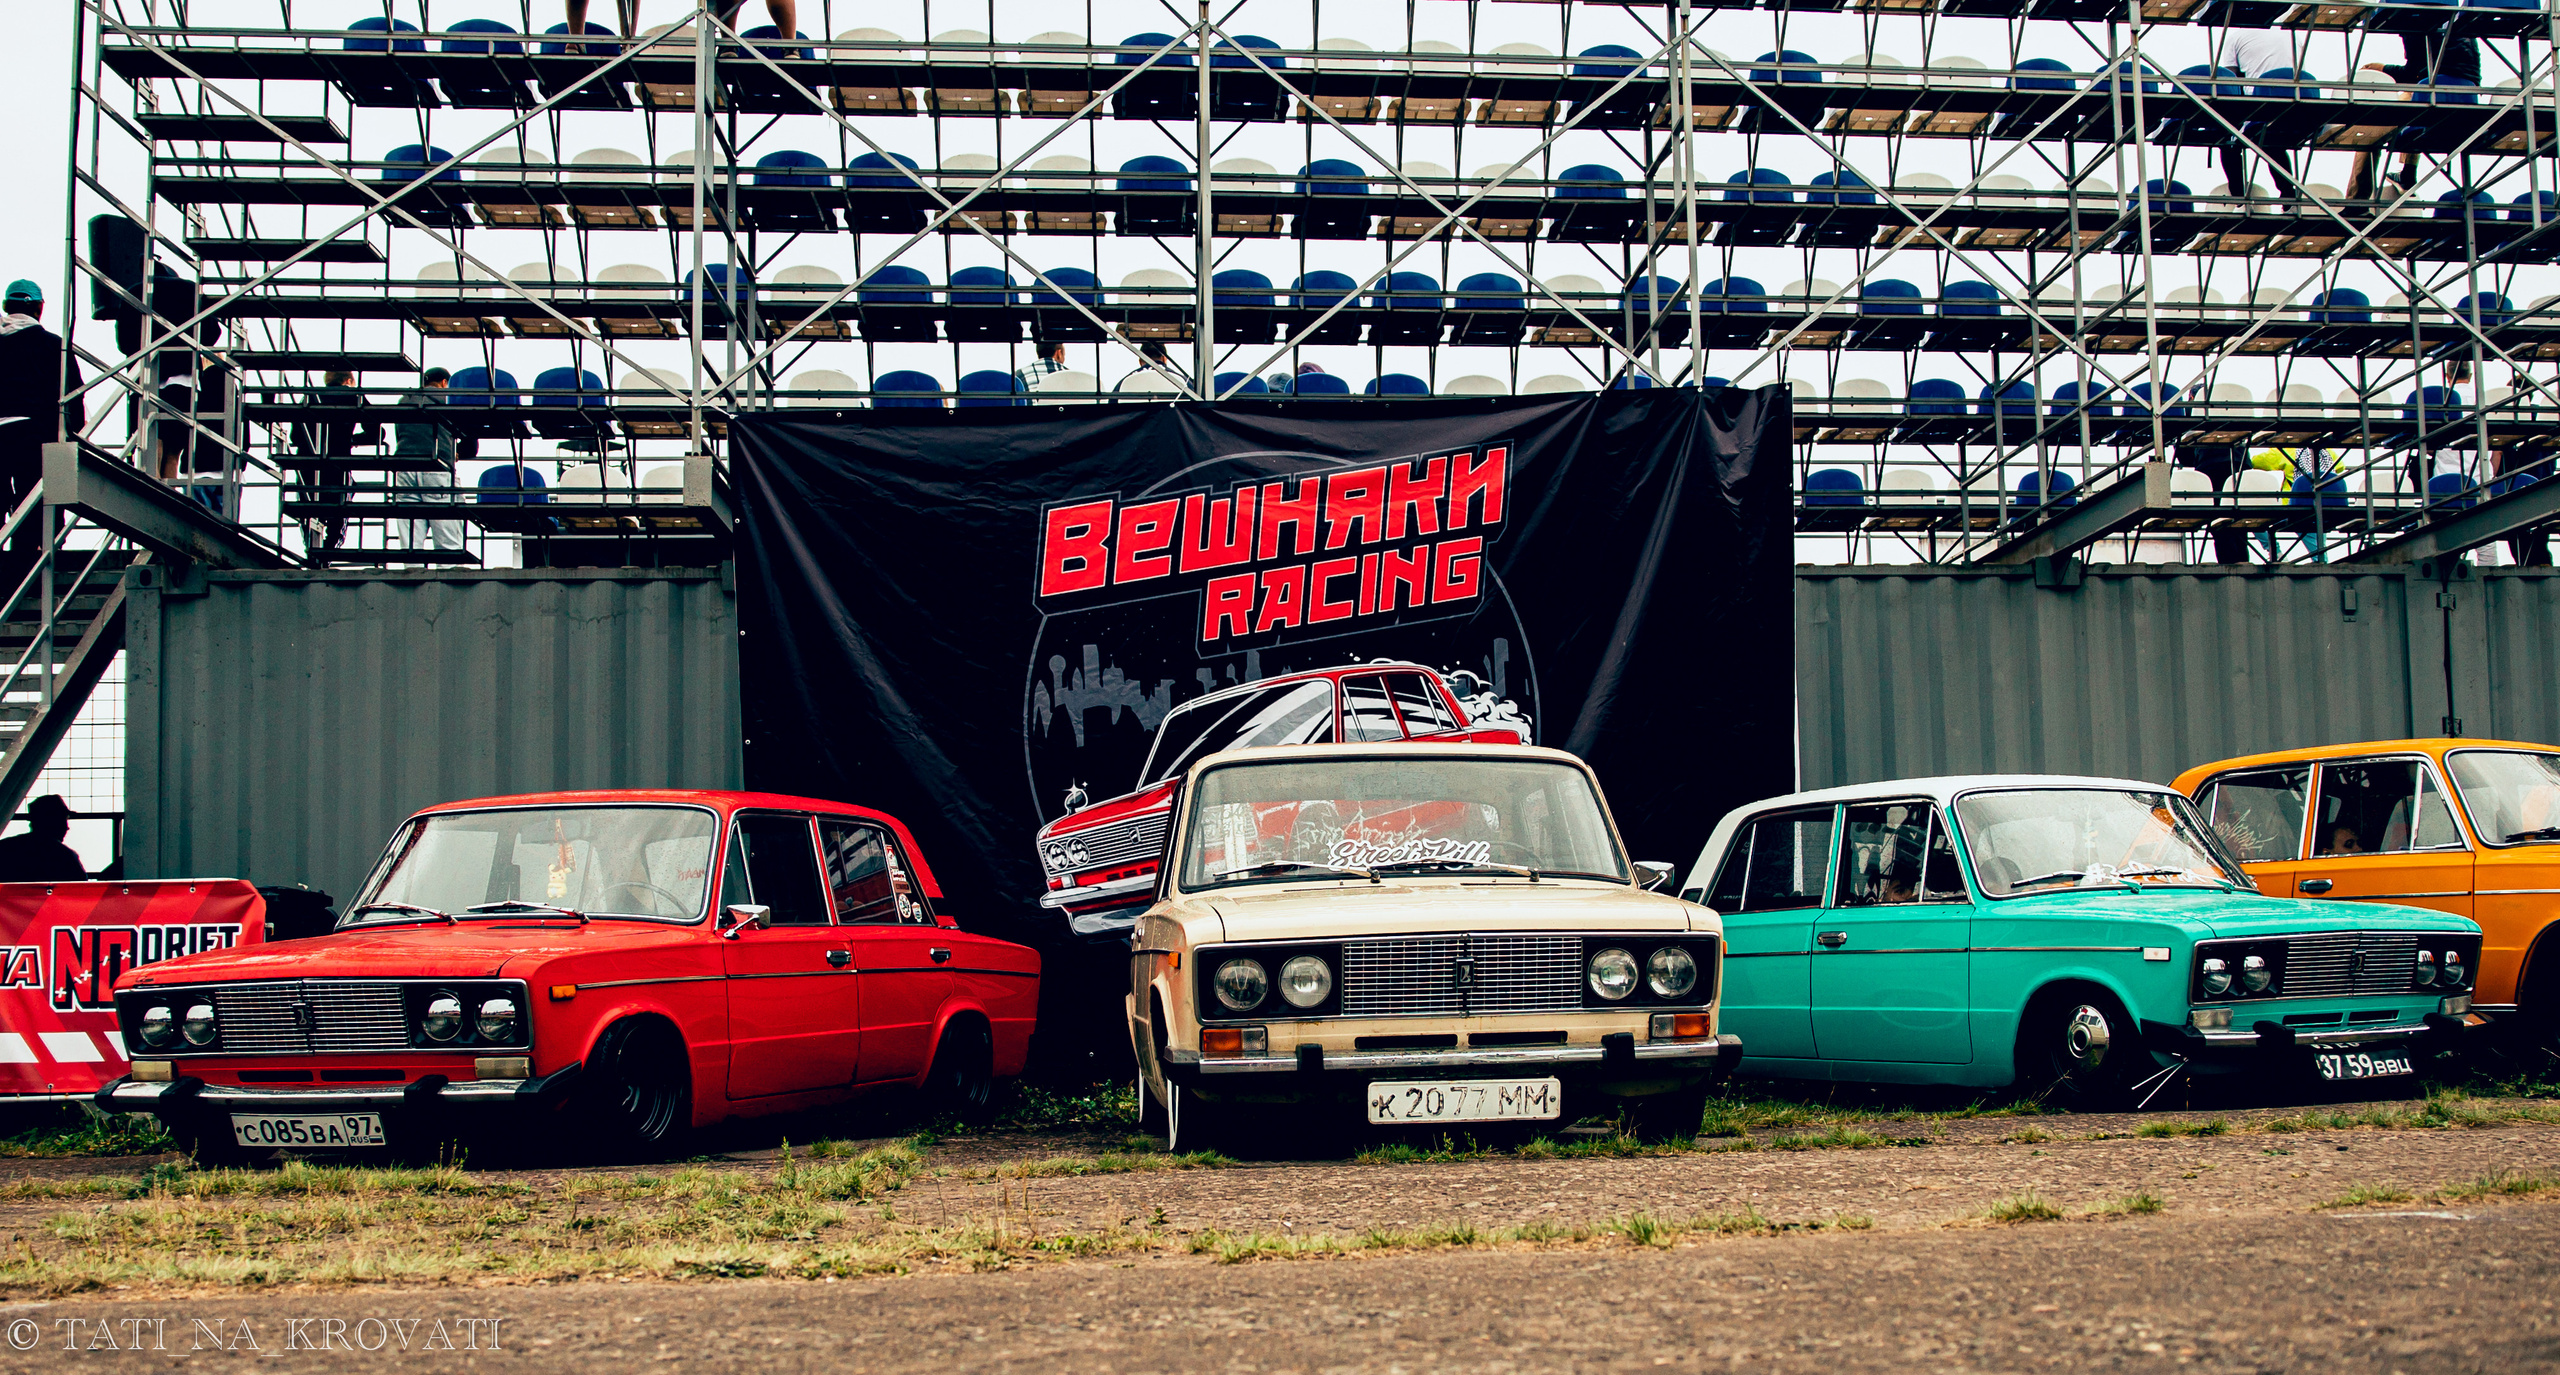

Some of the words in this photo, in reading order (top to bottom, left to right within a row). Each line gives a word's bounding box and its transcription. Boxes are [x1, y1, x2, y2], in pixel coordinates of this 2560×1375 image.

[1202, 535, 1483, 642] RACING
[2318, 1053, 2342, 1079] 37
[2345, 1053, 2374, 1077] 59
[346, 1116, 371, 1136] 97
[350, 1135, 370, 1144] RUS
